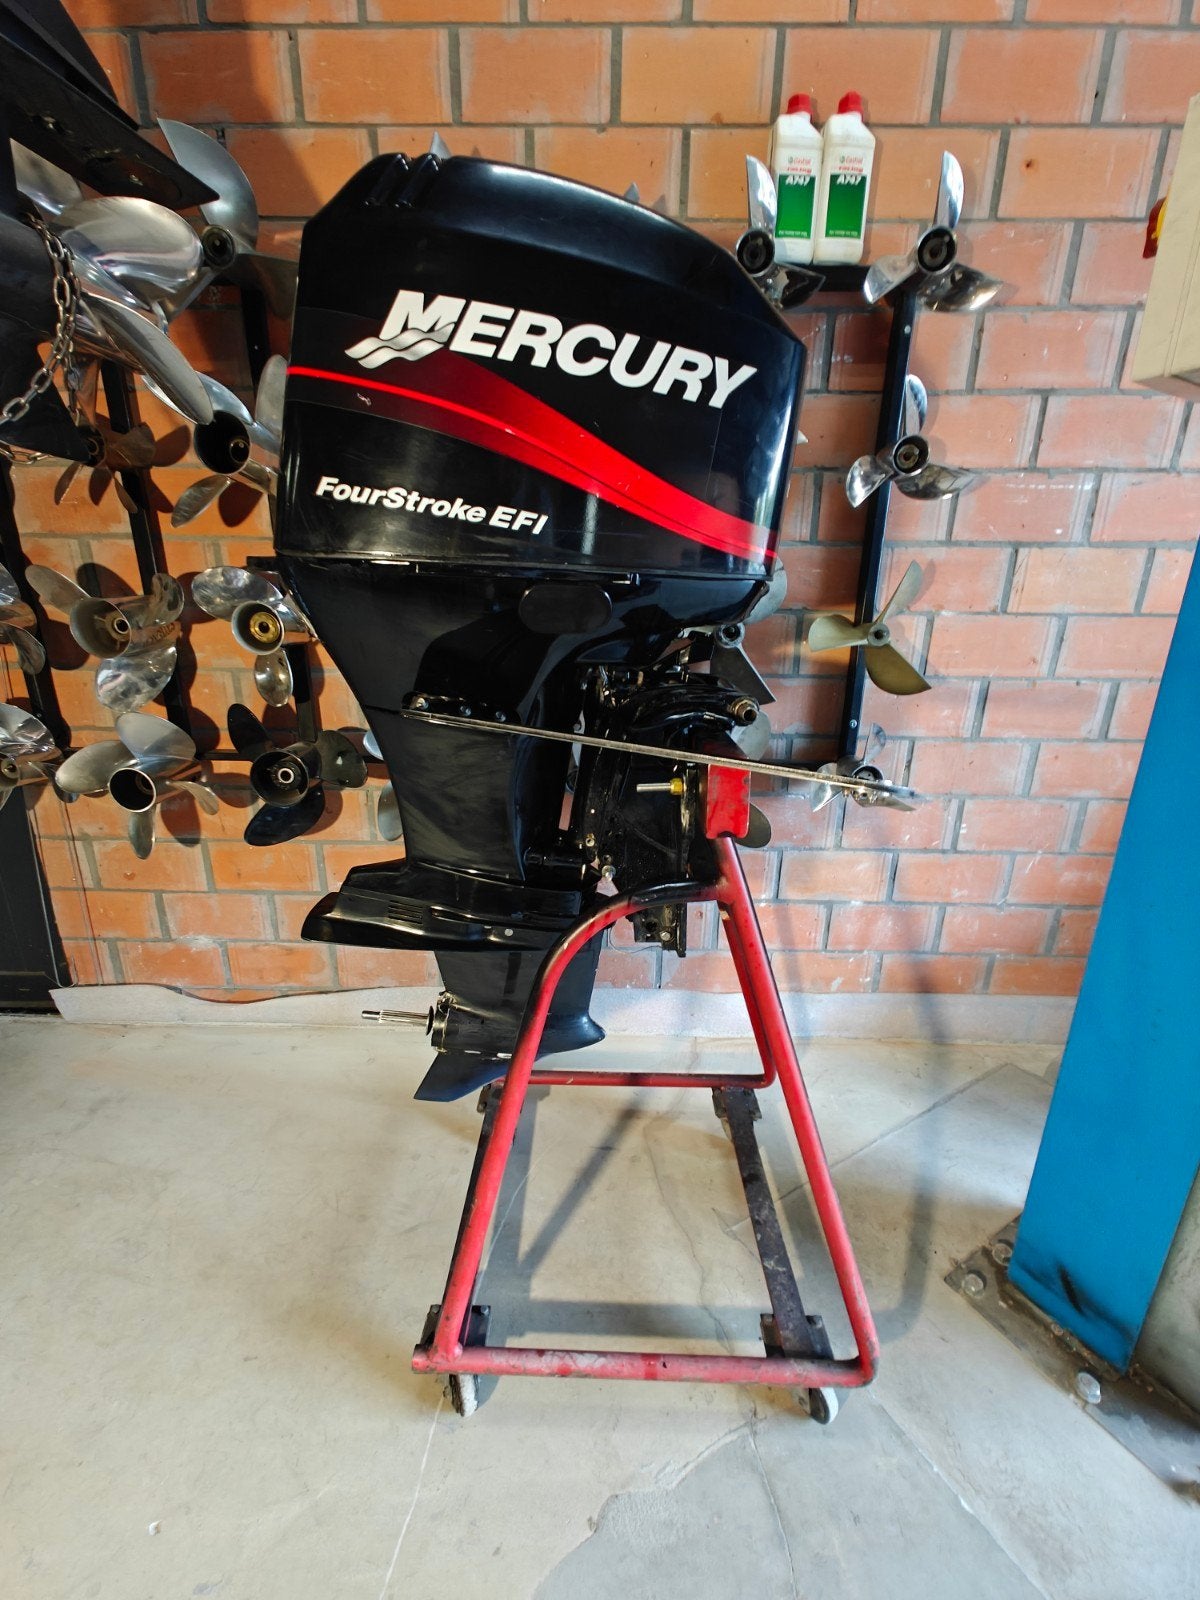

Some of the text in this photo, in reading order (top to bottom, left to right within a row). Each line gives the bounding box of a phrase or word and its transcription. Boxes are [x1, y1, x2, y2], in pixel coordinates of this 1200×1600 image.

[345, 289, 758, 409] MERCURY
[315, 476, 549, 535] FourStroke EFI
